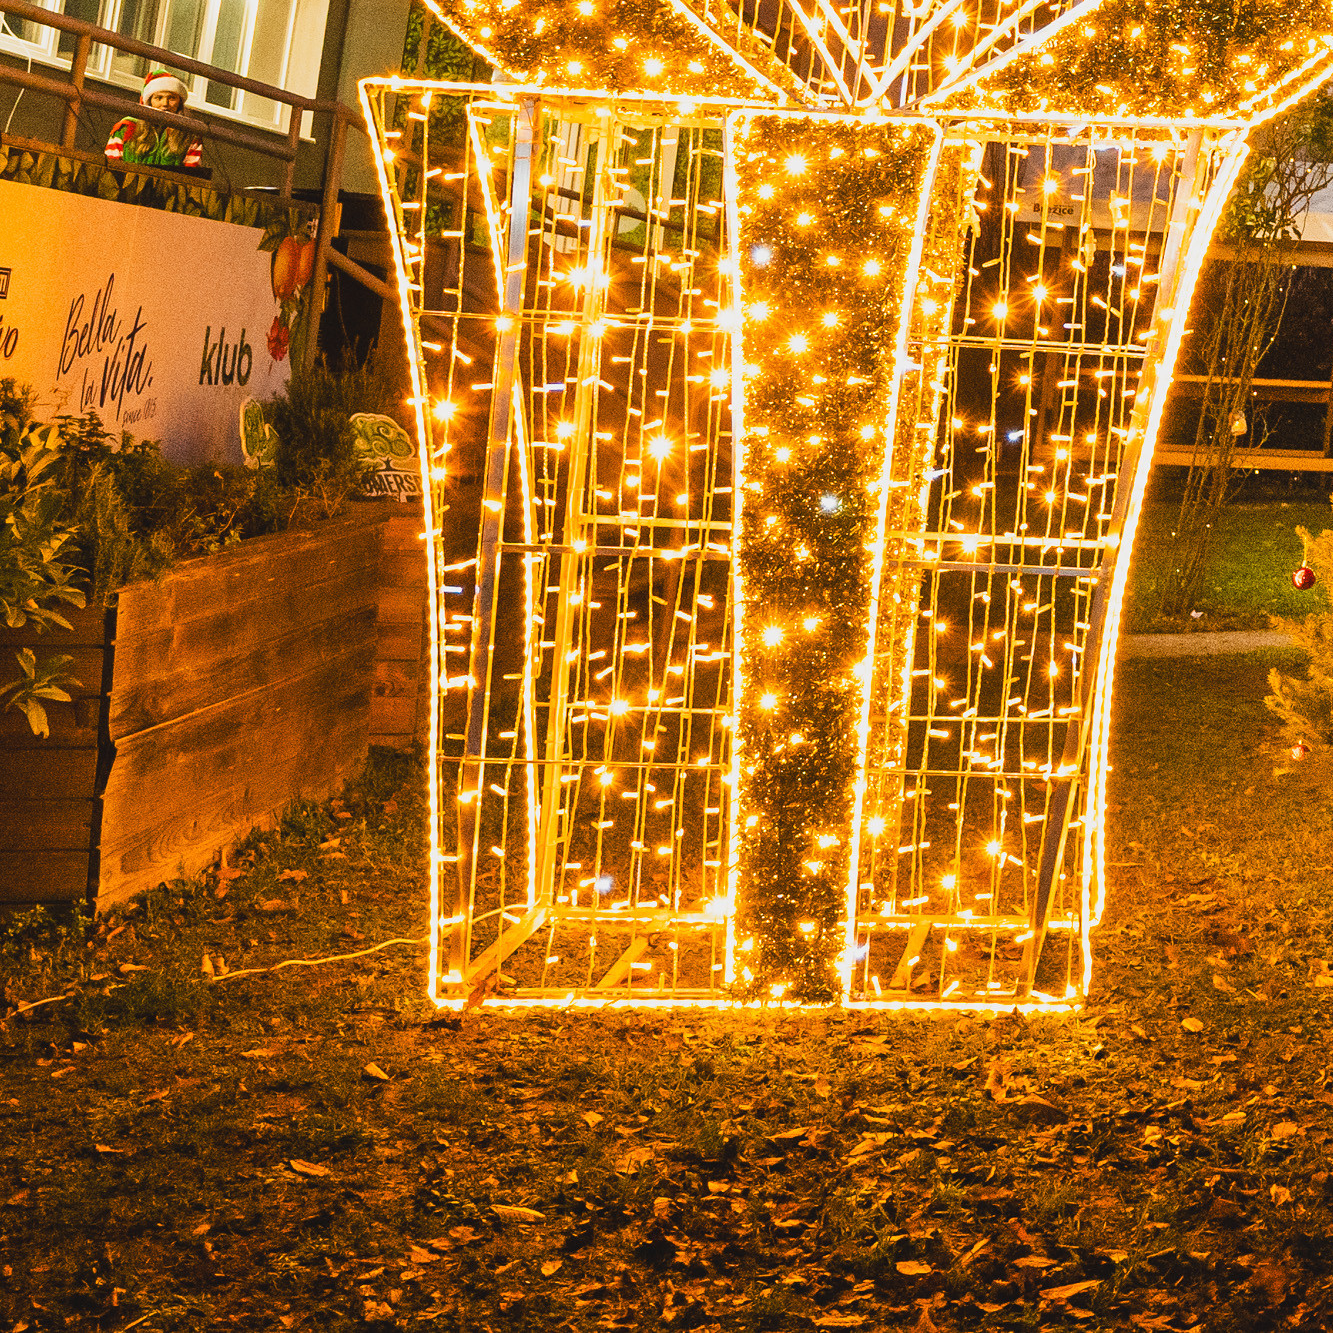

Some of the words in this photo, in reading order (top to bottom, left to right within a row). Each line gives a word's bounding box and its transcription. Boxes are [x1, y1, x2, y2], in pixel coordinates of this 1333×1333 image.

[56, 272, 122, 381] Bella
[198, 325, 253, 387] klub
[80, 367, 99, 414] la
